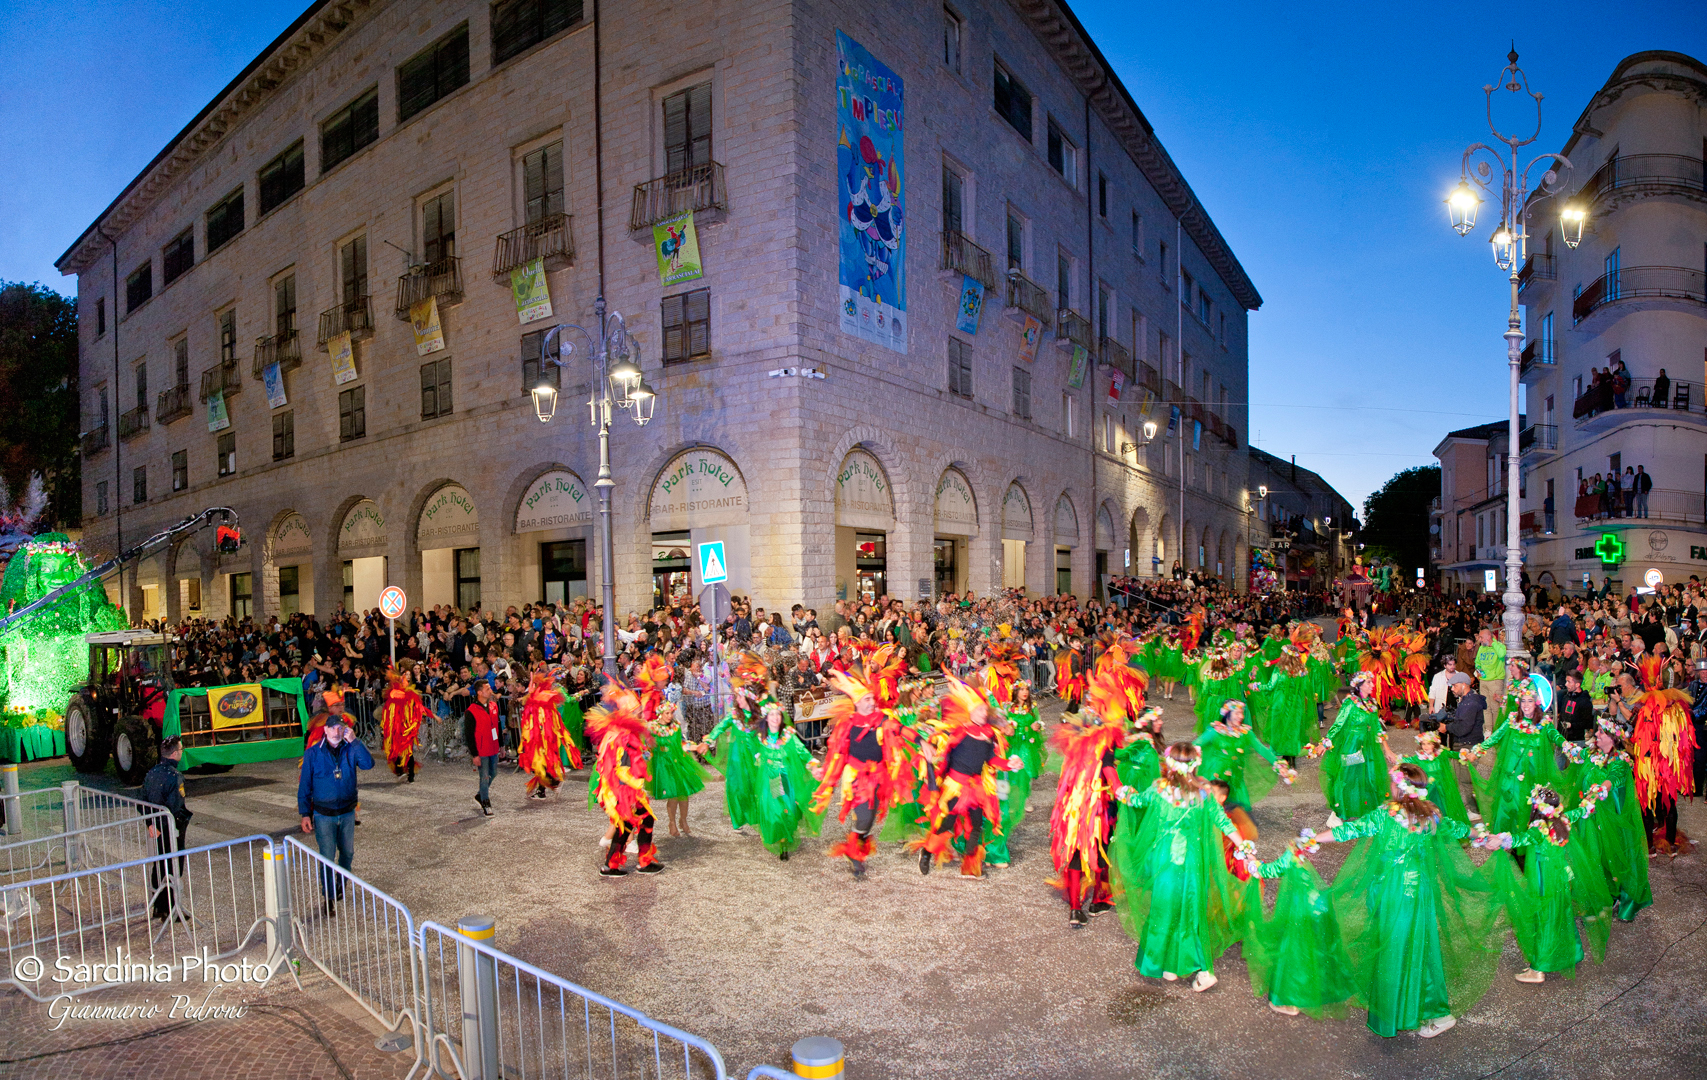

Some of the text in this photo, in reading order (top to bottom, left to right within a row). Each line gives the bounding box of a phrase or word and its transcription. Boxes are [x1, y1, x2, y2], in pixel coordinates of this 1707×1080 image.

[662, 458, 734, 494] Park Hotel
[837, 460, 860, 488] Park
[526, 477, 584, 510] Park Hotel
[426, 492, 474, 520] Park Hotel
[655, 496, 742, 514] BAR-RISTORANTE
[521, 511, 590, 528] BAR-RISTORANTE
[422, 522, 479, 537] BAR-RISTORANTE
[1270, 541, 1290, 549] BAR
[1690, 545, 1707, 560] FA
